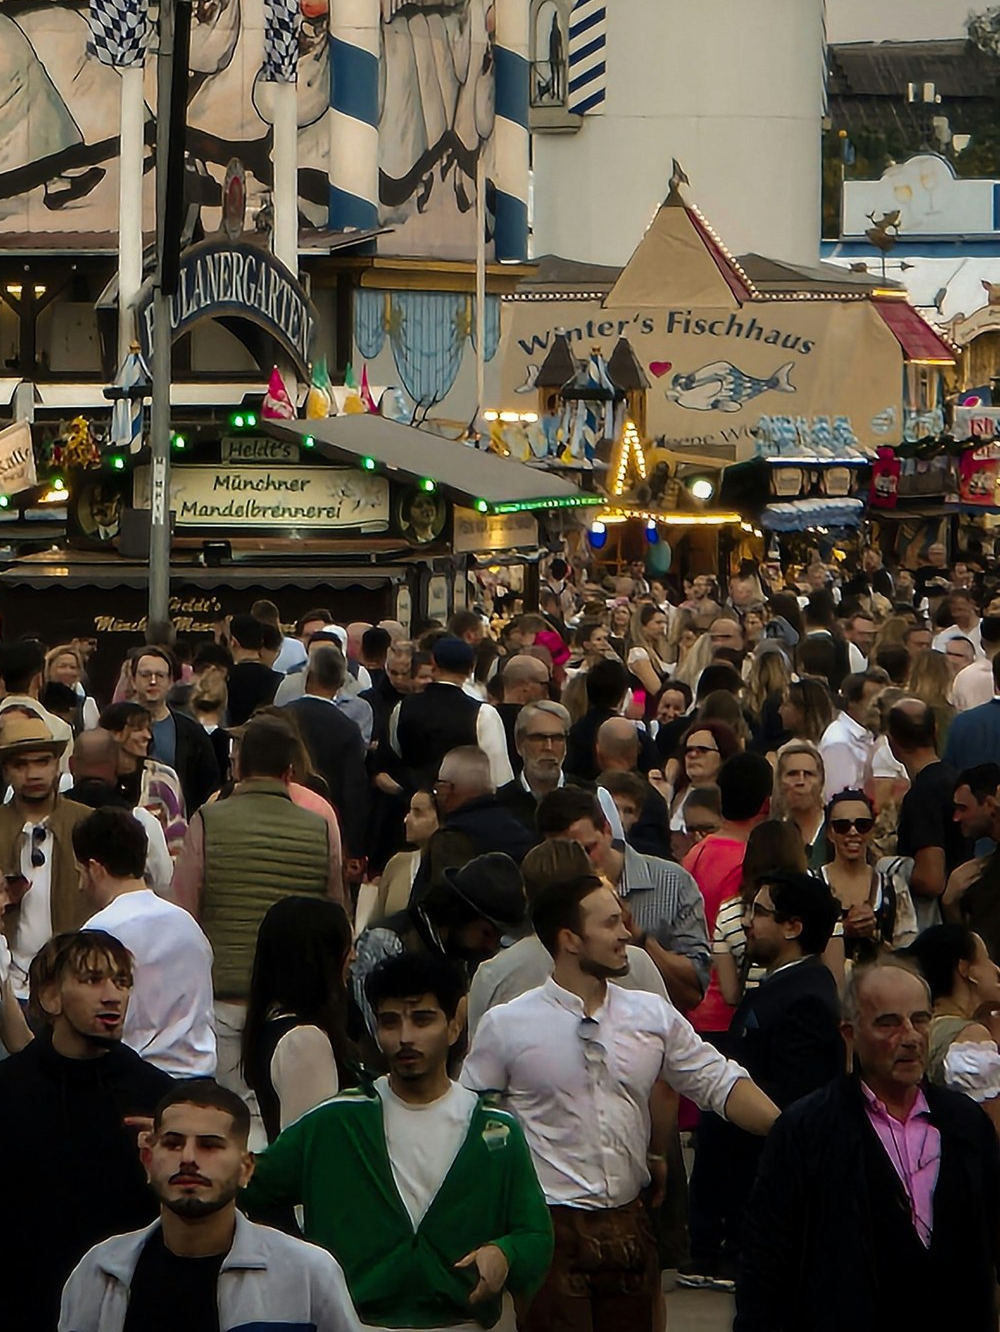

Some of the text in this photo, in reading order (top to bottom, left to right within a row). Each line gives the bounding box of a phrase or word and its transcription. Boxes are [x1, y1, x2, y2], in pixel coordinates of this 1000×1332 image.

[667, 309, 816, 355] Fischhaus
[228, 441, 292, 459] Heldt's
[213, 474, 312, 493] Münchner
[181, 501, 344, 519] Mandelbrennerei
